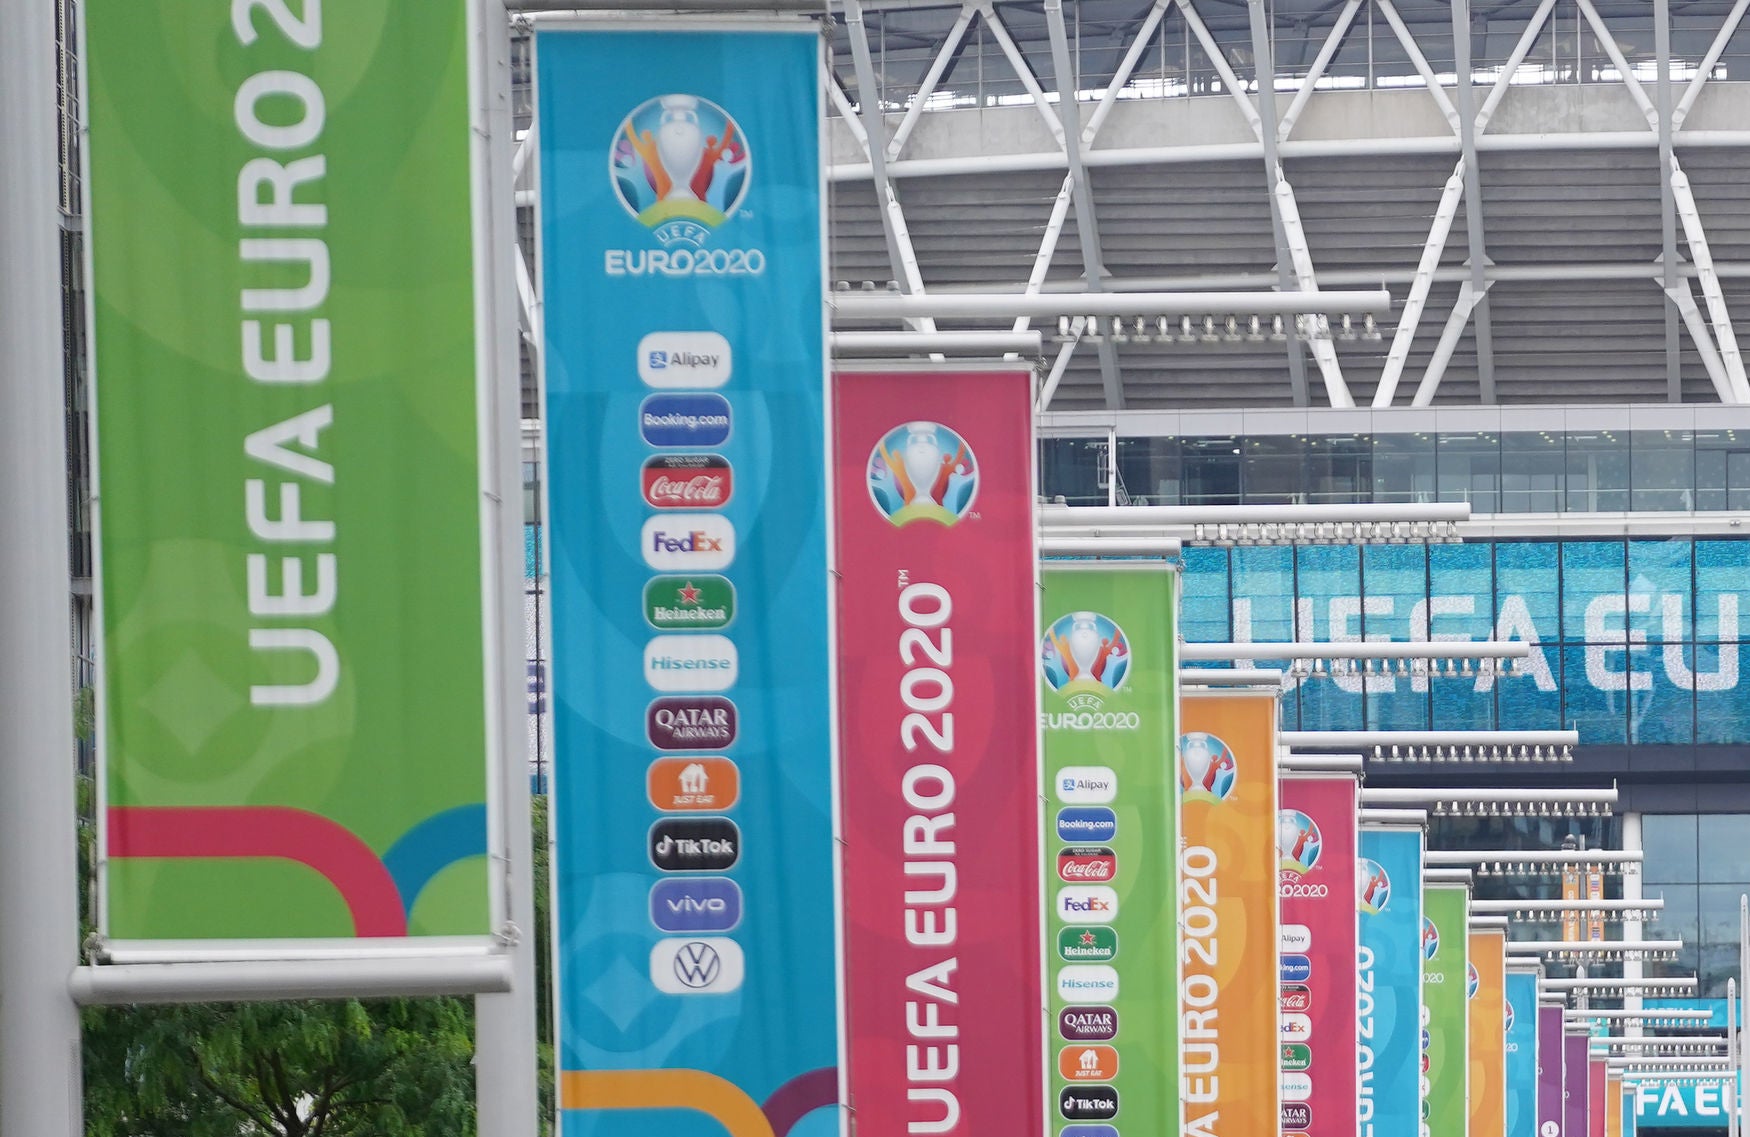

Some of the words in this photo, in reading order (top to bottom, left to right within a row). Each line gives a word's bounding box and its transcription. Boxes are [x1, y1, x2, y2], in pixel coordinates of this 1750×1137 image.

[234, 69, 332, 384] EURO
[604, 248, 767, 276] EURO2020
[670, 351, 720, 368] Alipay
[643, 412, 729, 429] Booking.com
[653, 530, 723, 552] FedEx
[243, 404, 341, 706] UEFA
[653, 606, 727, 621] Heineken
[1232, 595, 1557, 693] UEFA
[651, 656, 731, 670] Hisense
[898, 582, 955, 753] 2020
[1068, 695, 1102, 711] UEFA
[655, 709, 729, 730] QATAR
[672, 727, 729, 740] AIRWAYS
[1077, 779, 1110, 790] Alipay
[1059, 819, 1114, 830] Booking.com
[674, 838, 734, 856] TikTok
[901, 763, 957, 946] EURO
[667, 896, 726, 912] vivo
[1064, 897, 1110, 911] FedEx
[1181, 845, 1218, 969] 2020
[1064, 946, 1111, 956] Heineken
[1062, 979, 1114, 988] Hisense
[1064, 1013, 1112, 1028] QATAR
[1076, 1025, 1112, 1033] AIRWAYS
[905, 957, 961, 1135] UEFA
[1183, 974, 1220, 1103] EURO
[1077, 1099, 1115, 1110] TikTok
[1282, 1109, 1306, 1118] ATAR
[1547, 1126, 1553, 1134] 1
